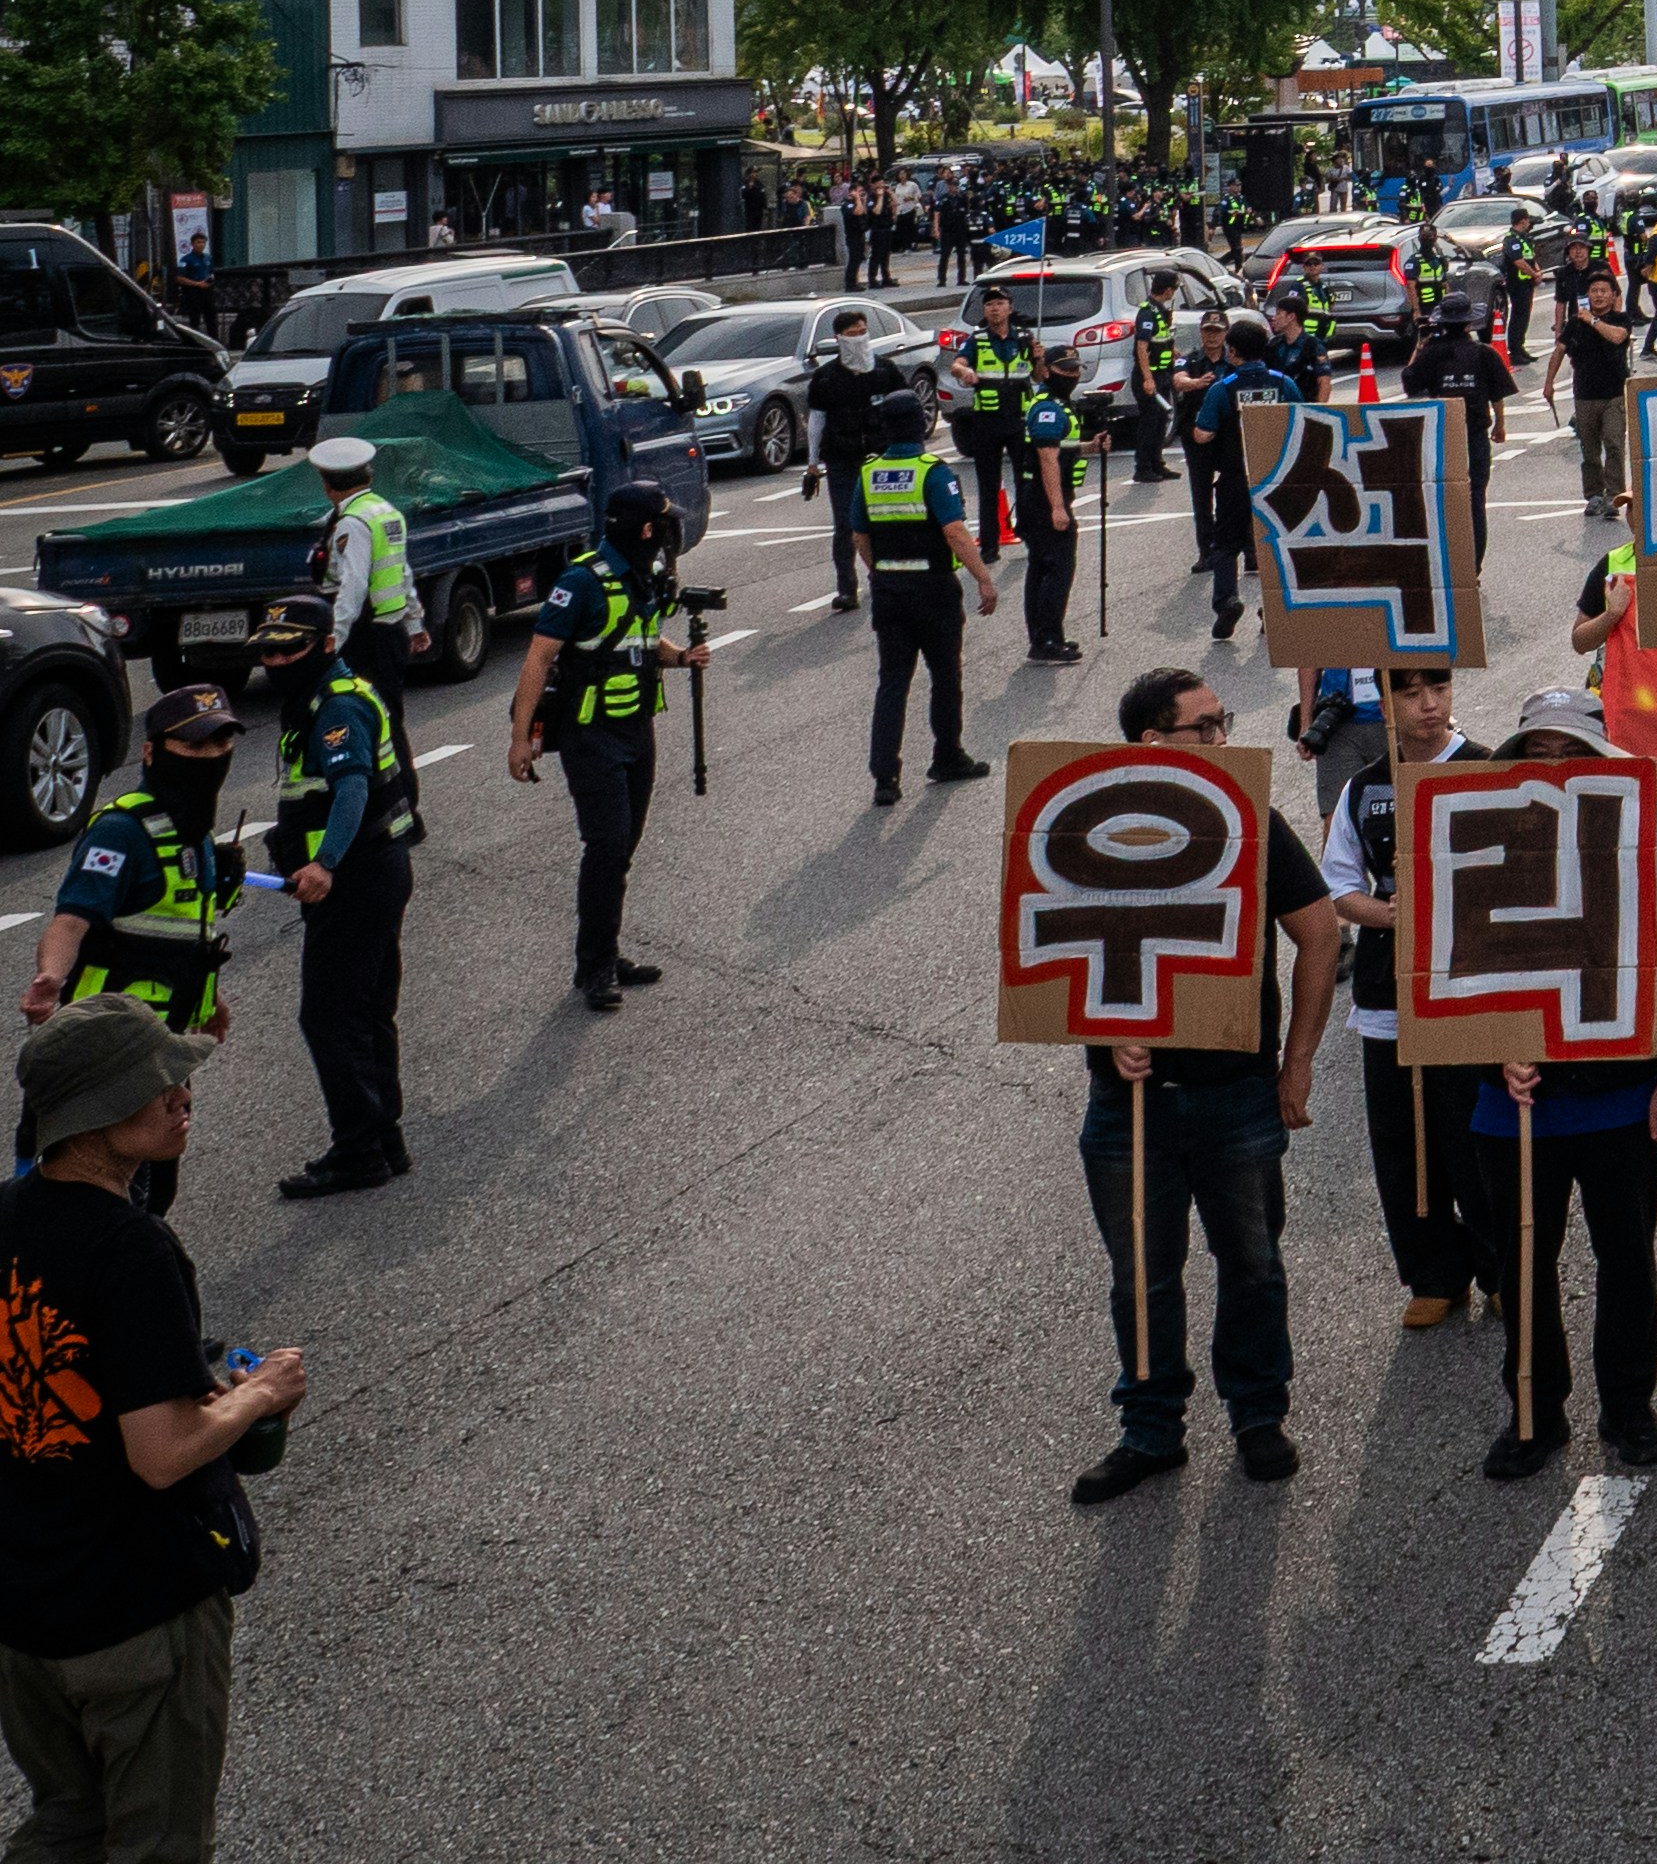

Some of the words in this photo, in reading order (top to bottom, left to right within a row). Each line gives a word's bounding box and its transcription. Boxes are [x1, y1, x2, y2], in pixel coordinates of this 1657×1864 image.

[1003, 232, 1041, 246] 12기-2
[874, 483, 908, 491] POLICE
[1253, 400, 1456, 658] 석
[148, 562, 244, 580] HYUNDAI
[1354, 677, 1374, 685] PRES
[1004, 748, 1259, 1035] 우
[1412, 758, 1657, 1056] 리
